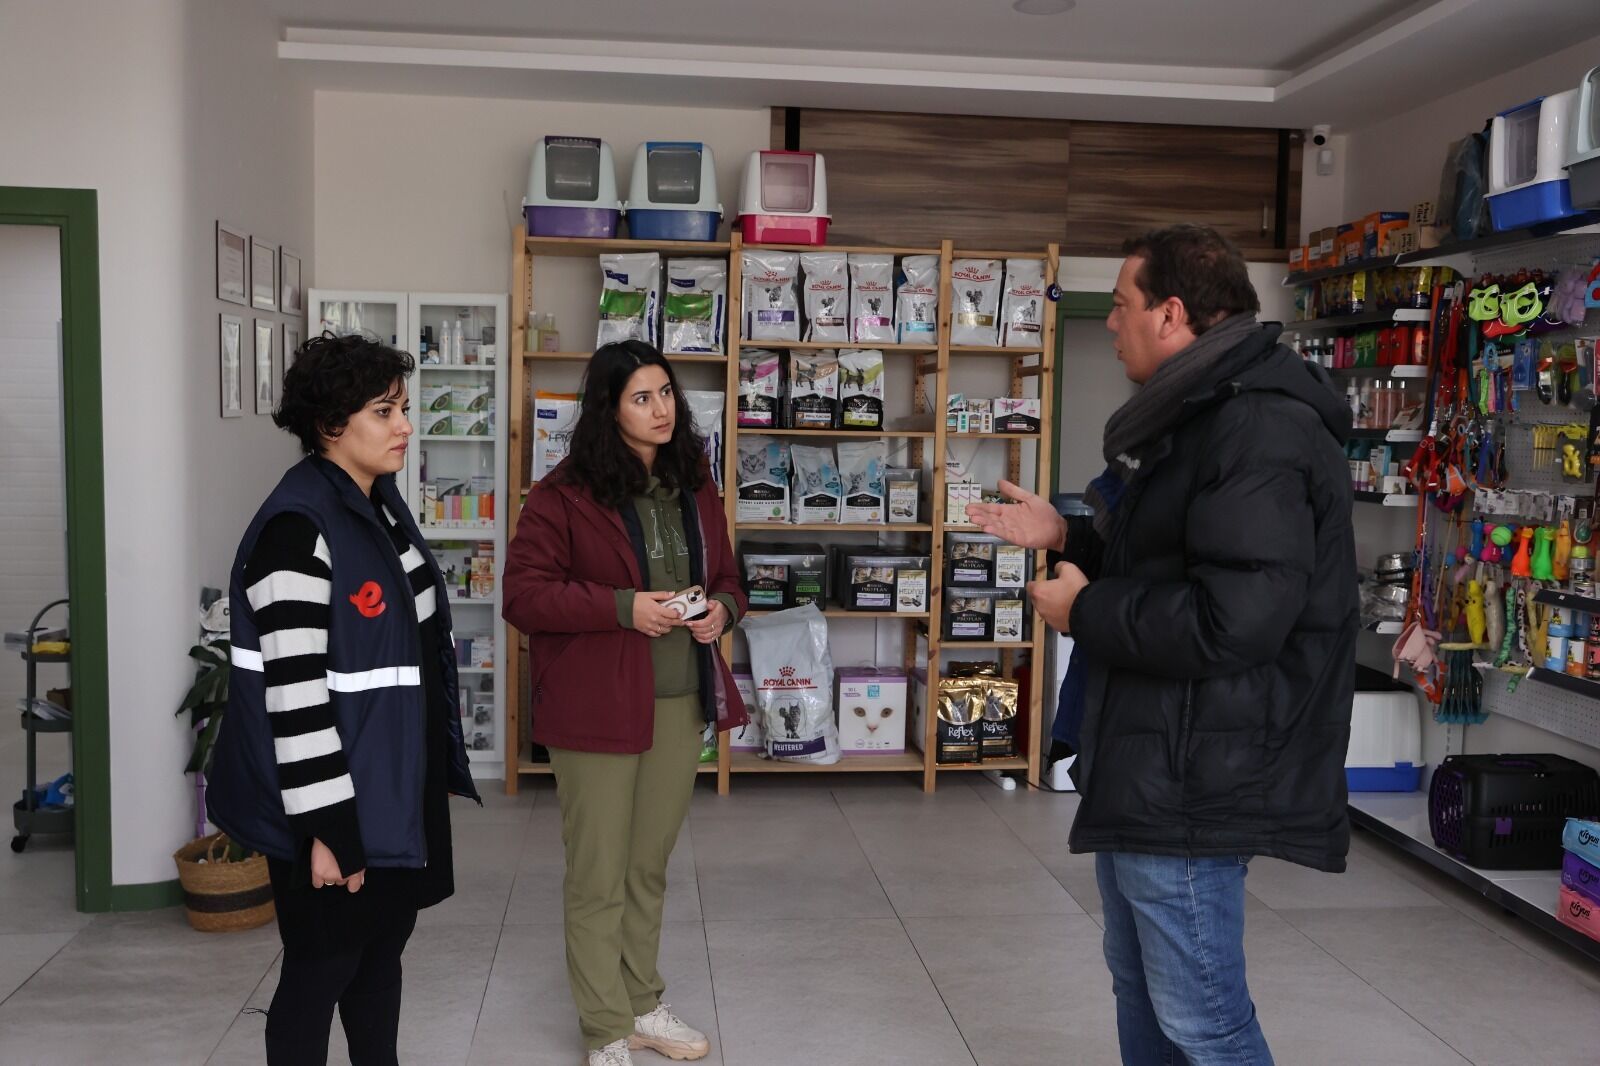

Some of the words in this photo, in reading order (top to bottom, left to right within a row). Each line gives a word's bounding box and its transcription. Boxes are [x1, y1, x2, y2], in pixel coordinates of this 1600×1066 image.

[948, 725, 974, 739] Reflex
[983, 722, 1008, 733] Reflex
[773, 743, 804, 751] NEUTERED
